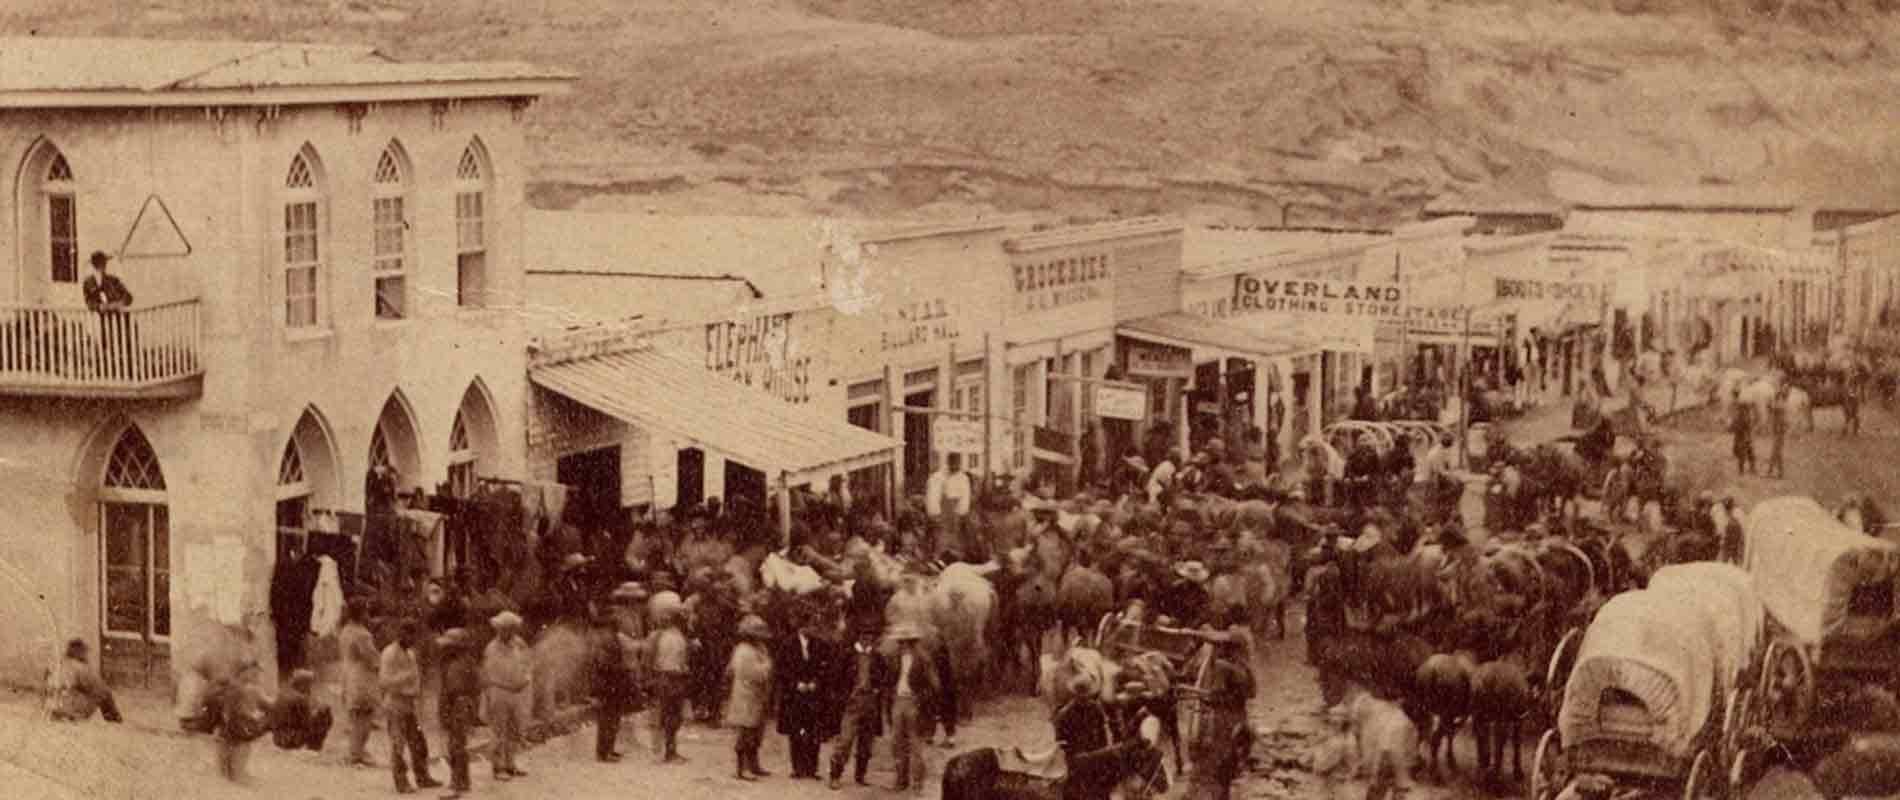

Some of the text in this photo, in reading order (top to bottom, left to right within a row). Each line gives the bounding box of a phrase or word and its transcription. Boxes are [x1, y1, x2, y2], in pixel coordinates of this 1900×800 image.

[1243, 277, 1401, 301] OVERLAND
[1242, 295, 1328, 312] CLOTHING
[1345, 300, 1402, 317] STORE
